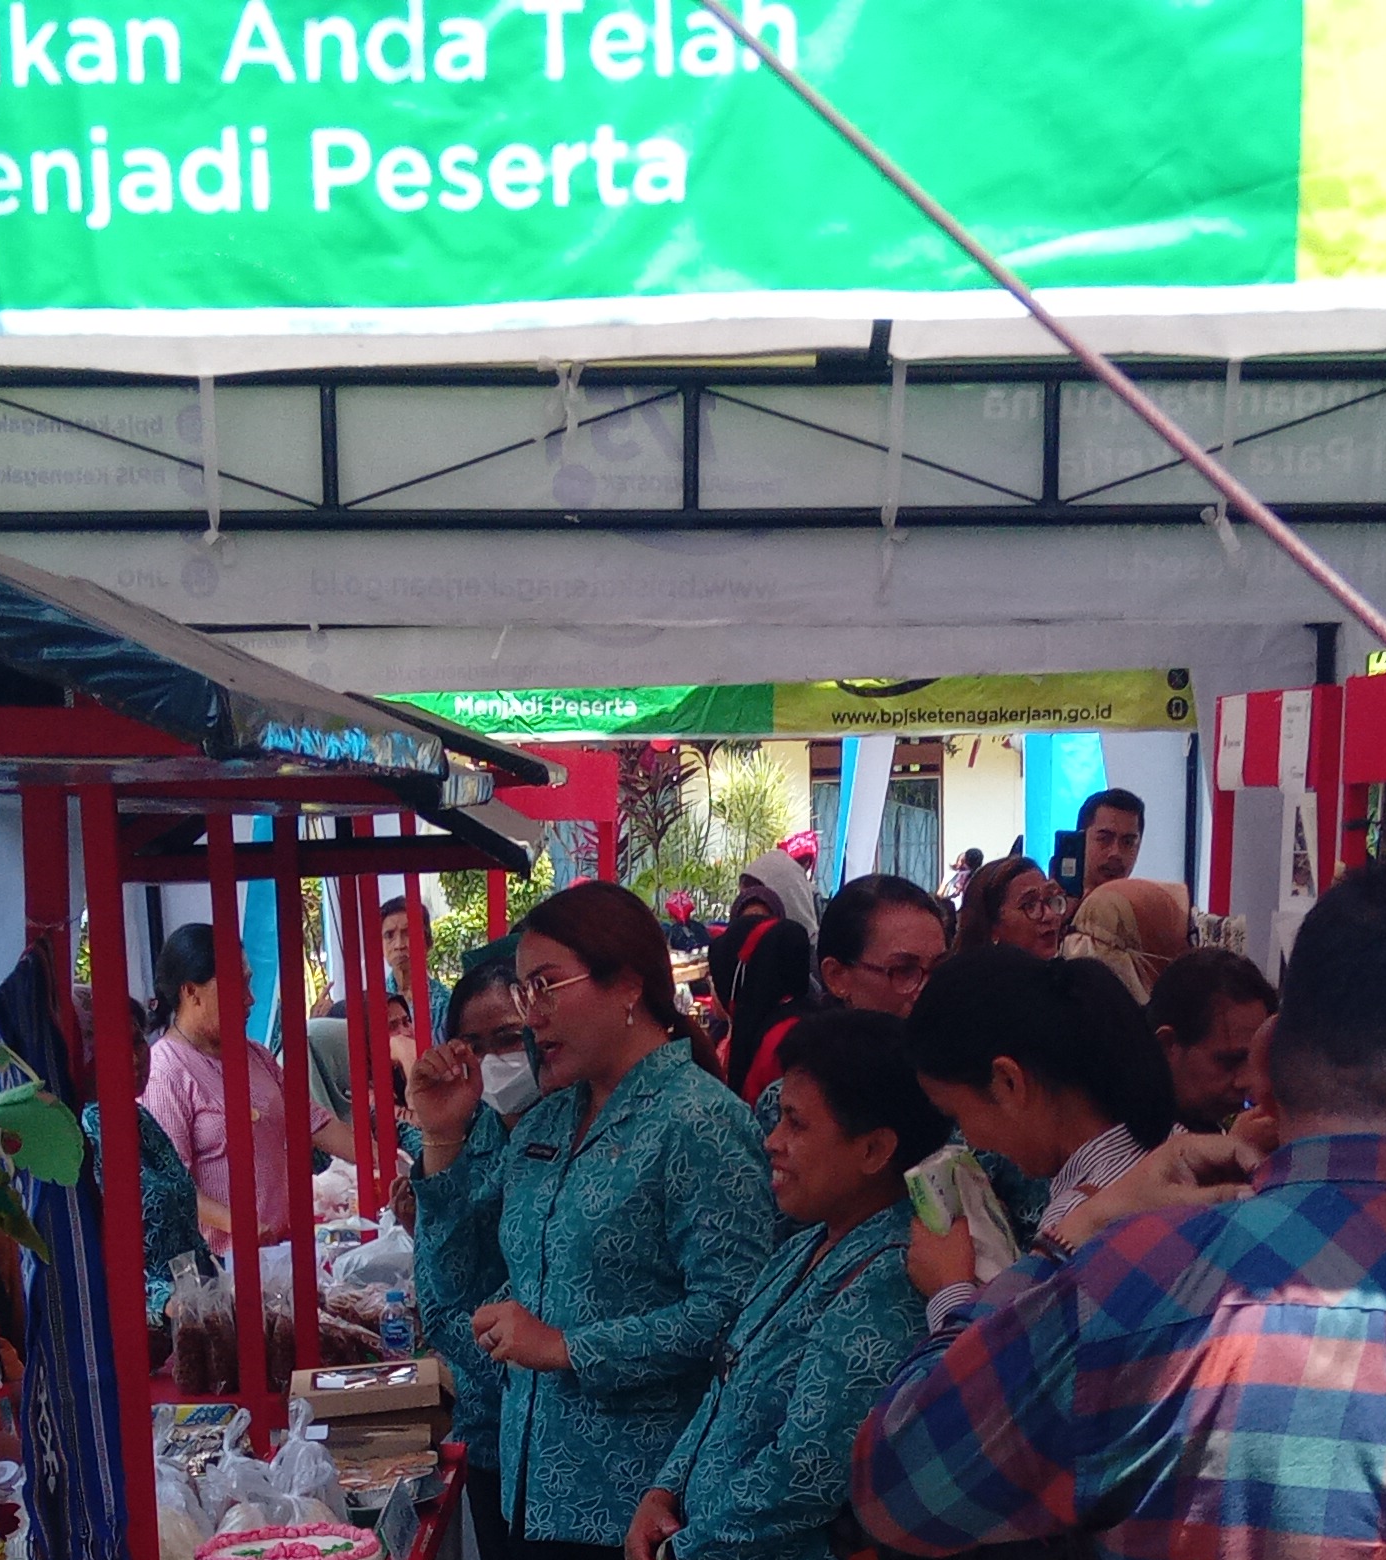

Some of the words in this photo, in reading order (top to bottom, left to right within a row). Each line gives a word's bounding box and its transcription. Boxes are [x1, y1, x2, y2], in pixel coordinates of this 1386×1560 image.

[219, 0, 489, 84] Anda
[524, 0, 798, 82] Telah
[310, 124, 689, 213] Peserta
[454, 696, 544, 719] Menjadi
[550, 696, 638, 717] Peserta
[831, 703, 1114, 731] www.bpjsketenagakerjaan.go.id
